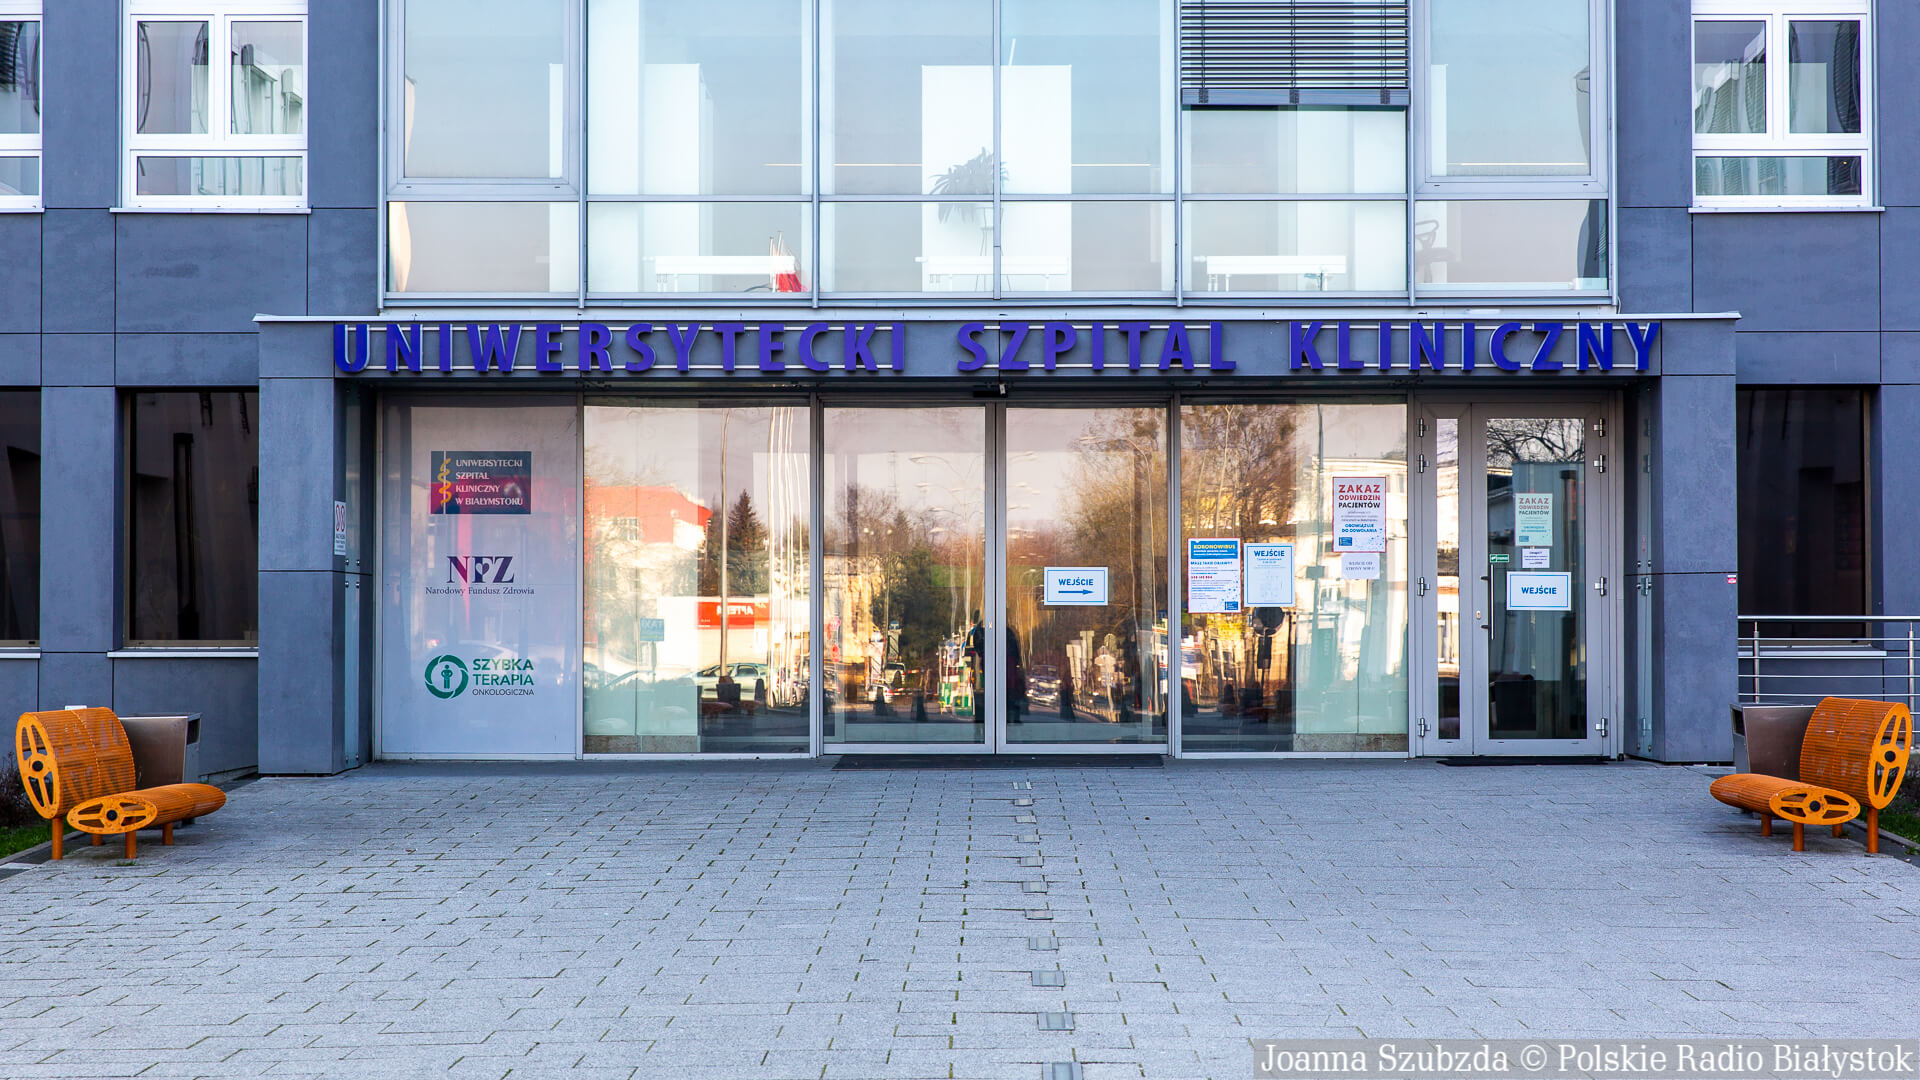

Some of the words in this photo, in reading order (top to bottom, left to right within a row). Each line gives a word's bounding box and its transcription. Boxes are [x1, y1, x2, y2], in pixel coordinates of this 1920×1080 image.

[334, 322, 904, 373] UNIWERSYTECKI
[956, 321, 1237, 371] SZPITAL
[1290, 320, 1661, 371] KLINICZNY
[455, 459, 523, 467] UNIWERSYTECKI
[455, 471, 490, 480] SZPITAL
[455, 484, 501, 493] KLINICZNY
[1338, 484, 1381, 494] ZAKAZ
[455, 497, 464, 506] W
[465, 497, 523, 506] BIAŁYMSTOKU
[1338, 501, 1381, 509] PACJENTÓW
[1519, 497, 1549, 505] ZAKAZ
[1253, 548, 1285, 557] WEJŚCIE
[446, 555, 515, 584] NFZ
[1058, 576, 1094, 586] WEJŚCIE
[425, 586, 465, 596] Narodowy
[468, 586, 500, 595] Fundusz
[502, 586, 535, 595] Zdrowia
[1521, 584, 1557, 595] WEJŚCIE
[472, 658, 535, 671] SZYBKA
[472, 673, 535, 686] TERAPIA
[472, 688, 535, 696] ONKOLOGICZNA
